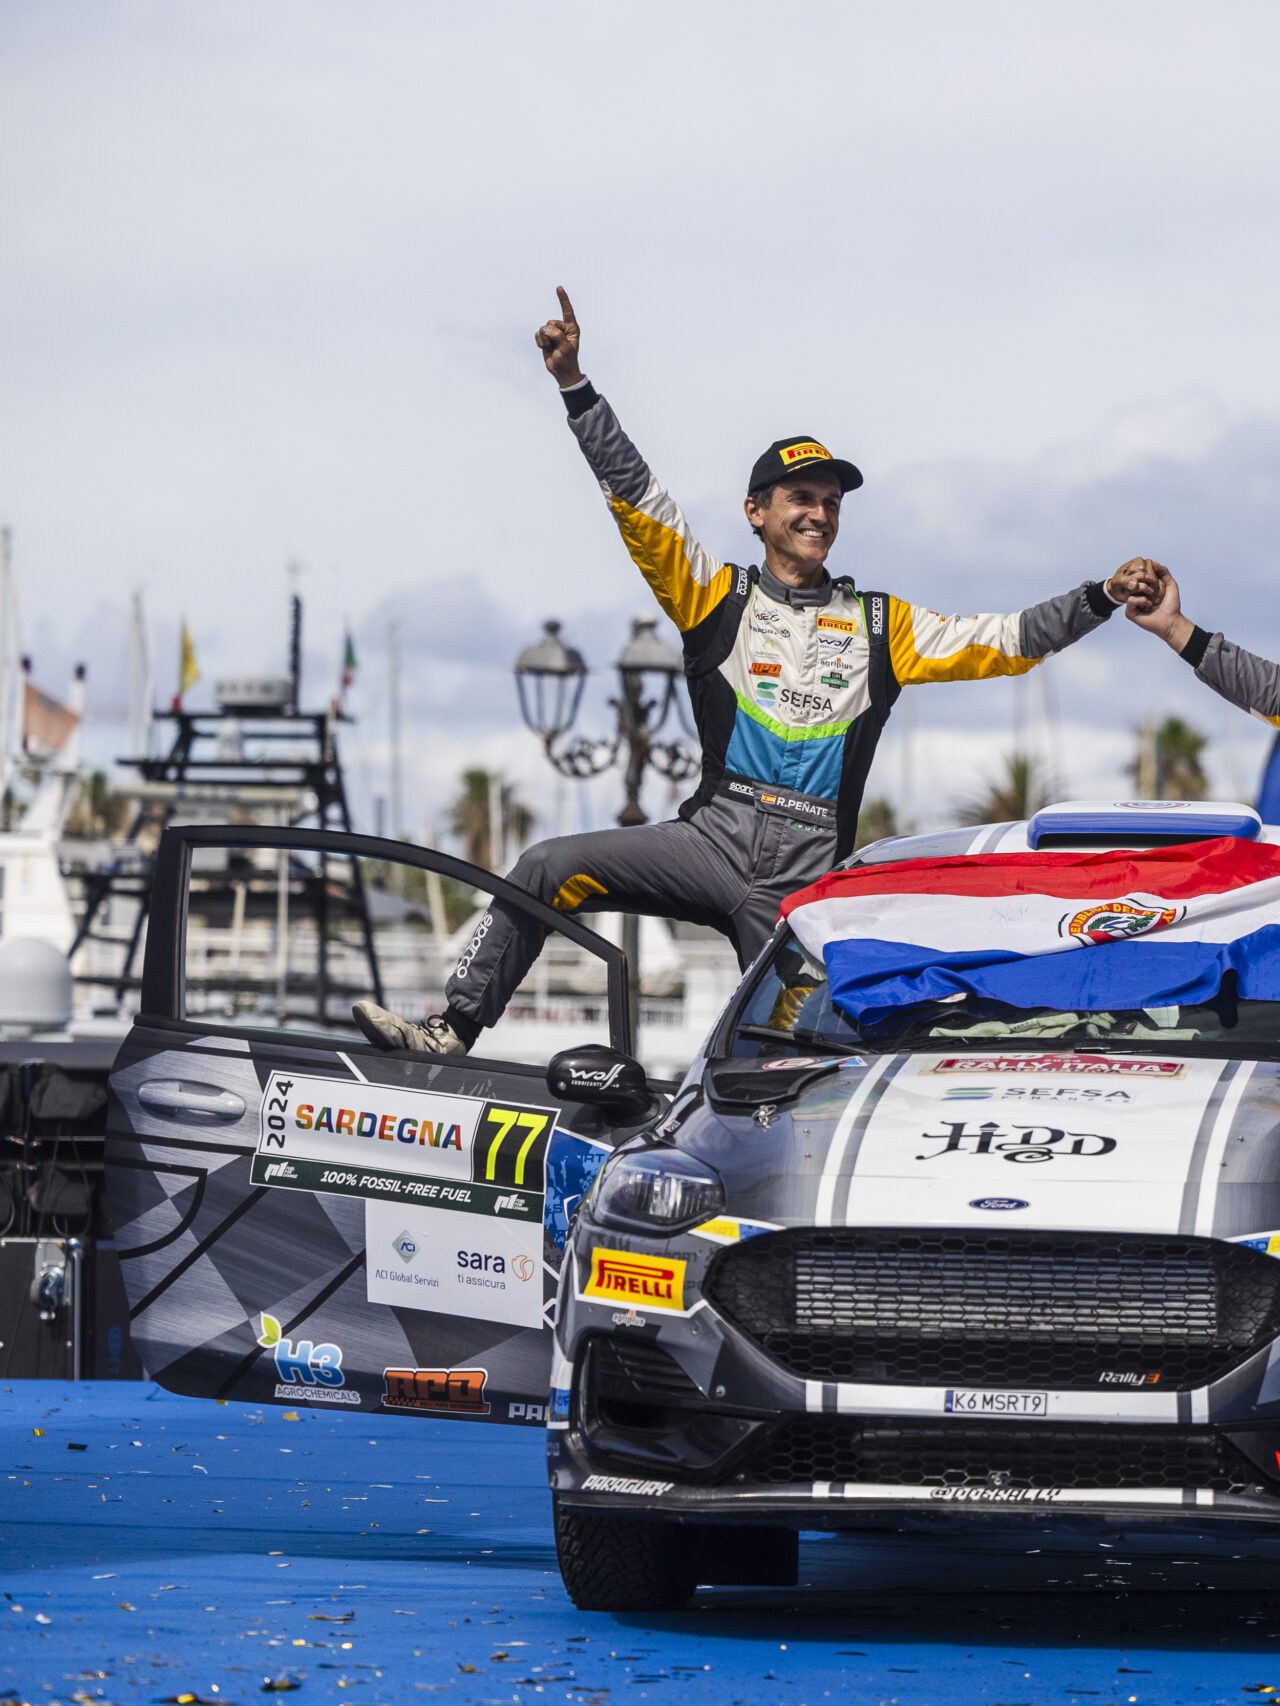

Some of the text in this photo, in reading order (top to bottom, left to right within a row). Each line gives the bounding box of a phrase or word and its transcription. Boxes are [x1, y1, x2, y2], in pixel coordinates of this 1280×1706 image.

[818, 618, 853, 632] PIRELLI
[872, 597, 882, 635] sparco
[780, 689, 833, 712] SEFSA
[728, 781, 754, 796] sparc
[776, 796, 828, 817] R.PEÑATE
[457, 913, 493, 978] sparco
[569, 1064, 626, 1090] wolf
[951, 1061, 1162, 1073] RALLY ITALIA
[1004, 1087, 1132, 1099] SEFSA
[267, 1080, 294, 1149] 2024
[295, 1104, 463, 1151] SARDEGNA
[486, 1108, 549, 1185] 77
[321, 1170, 472, 1203] 100% FOSSIL-FREE FUEL
[980, 1200, 1018, 1209] Ford
[400, 1242, 416, 1253] ACI
[457, 1250, 505, 1274] sara
[375, 1269, 439, 1287] ACI Global Servizi
[457, 1274, 506, 1290] ti assicura
[595, 1259, 674, 1299] PIRELLI
[275, 1339, 345, 1387] H3
[276, 1385, 360, 1402] AGROCHEMICALS
[385, 1371, 485, 1403] RPD
[954, 1393, 977, 1409] K6
[982, 1394, 1042, 1412] MSRT9
[581, 1474, 675, 1496] PARAGUAY
